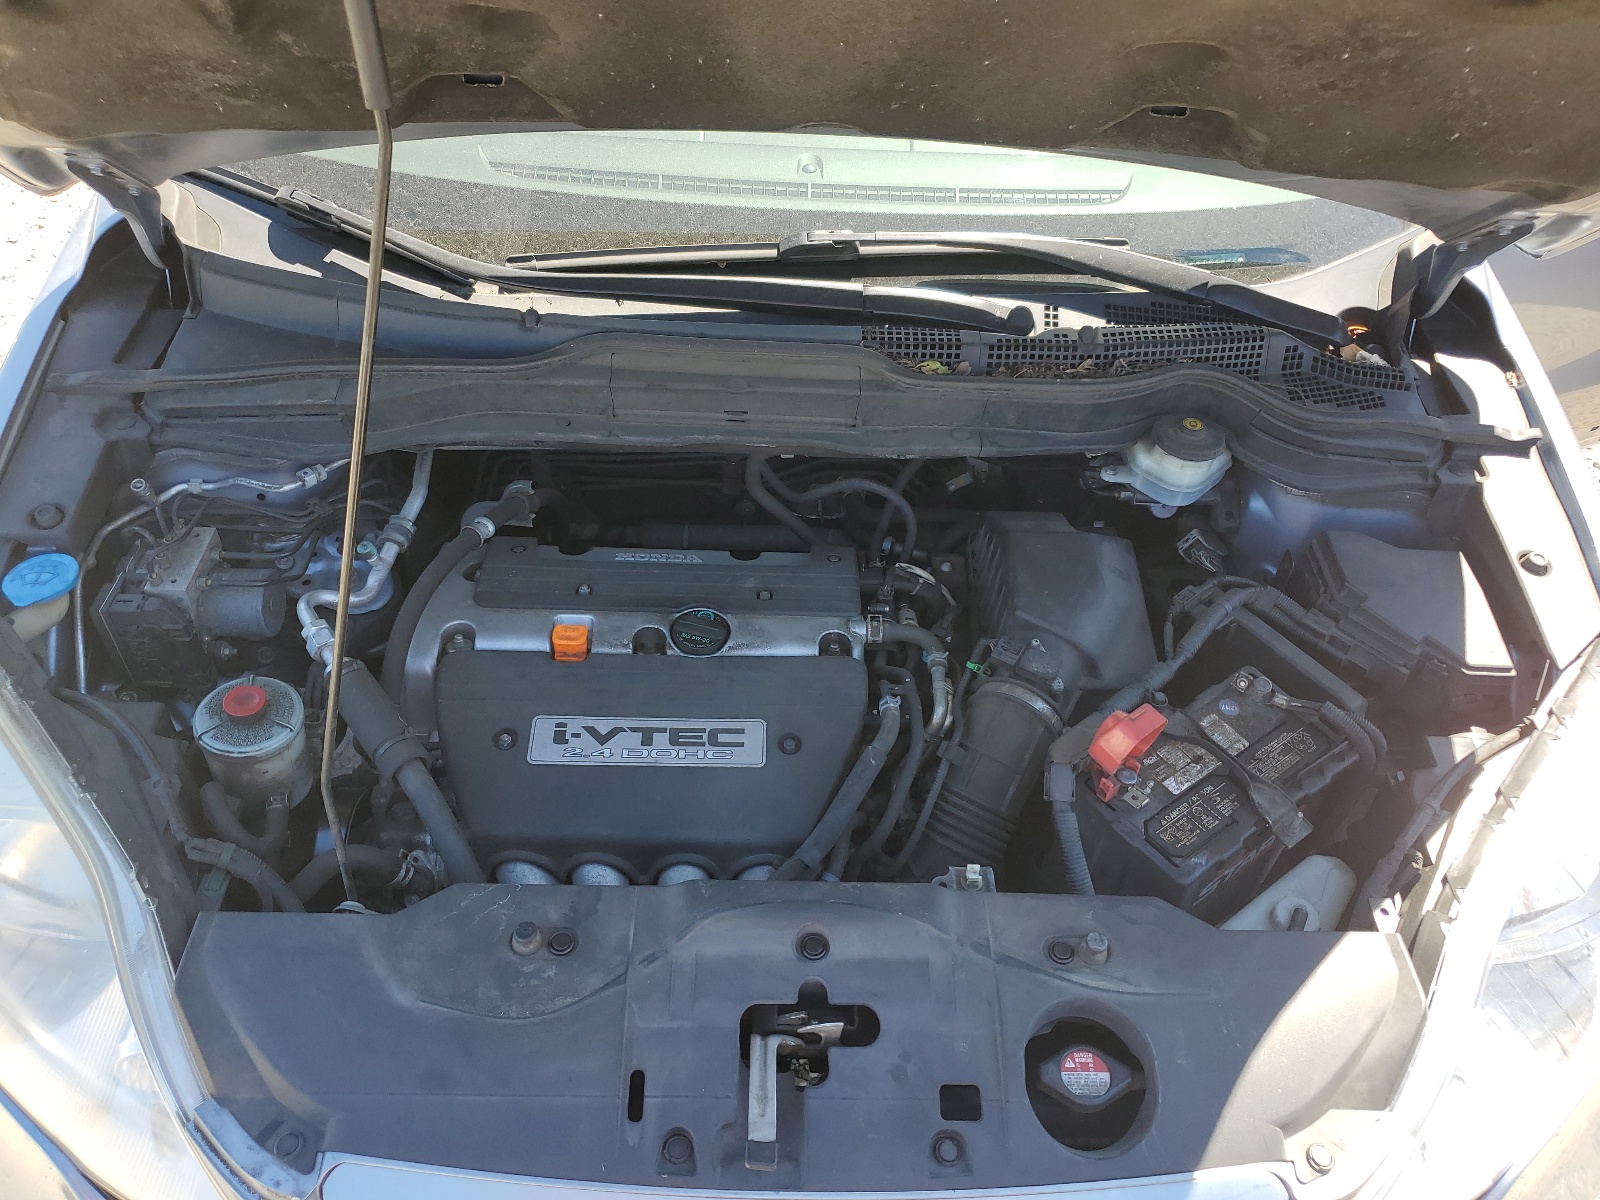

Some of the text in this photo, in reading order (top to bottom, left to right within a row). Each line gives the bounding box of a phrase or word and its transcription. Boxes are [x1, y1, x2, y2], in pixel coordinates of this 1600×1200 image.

[615, 552, 703, 563] HONDA
[552, 721, 746, 748] i-VTEC
[562, 747, 733, 760] 2.4 DOHC
[1165, 802, 1190, 822] DANGER
[1191, 784, 1215, 803] POSON
